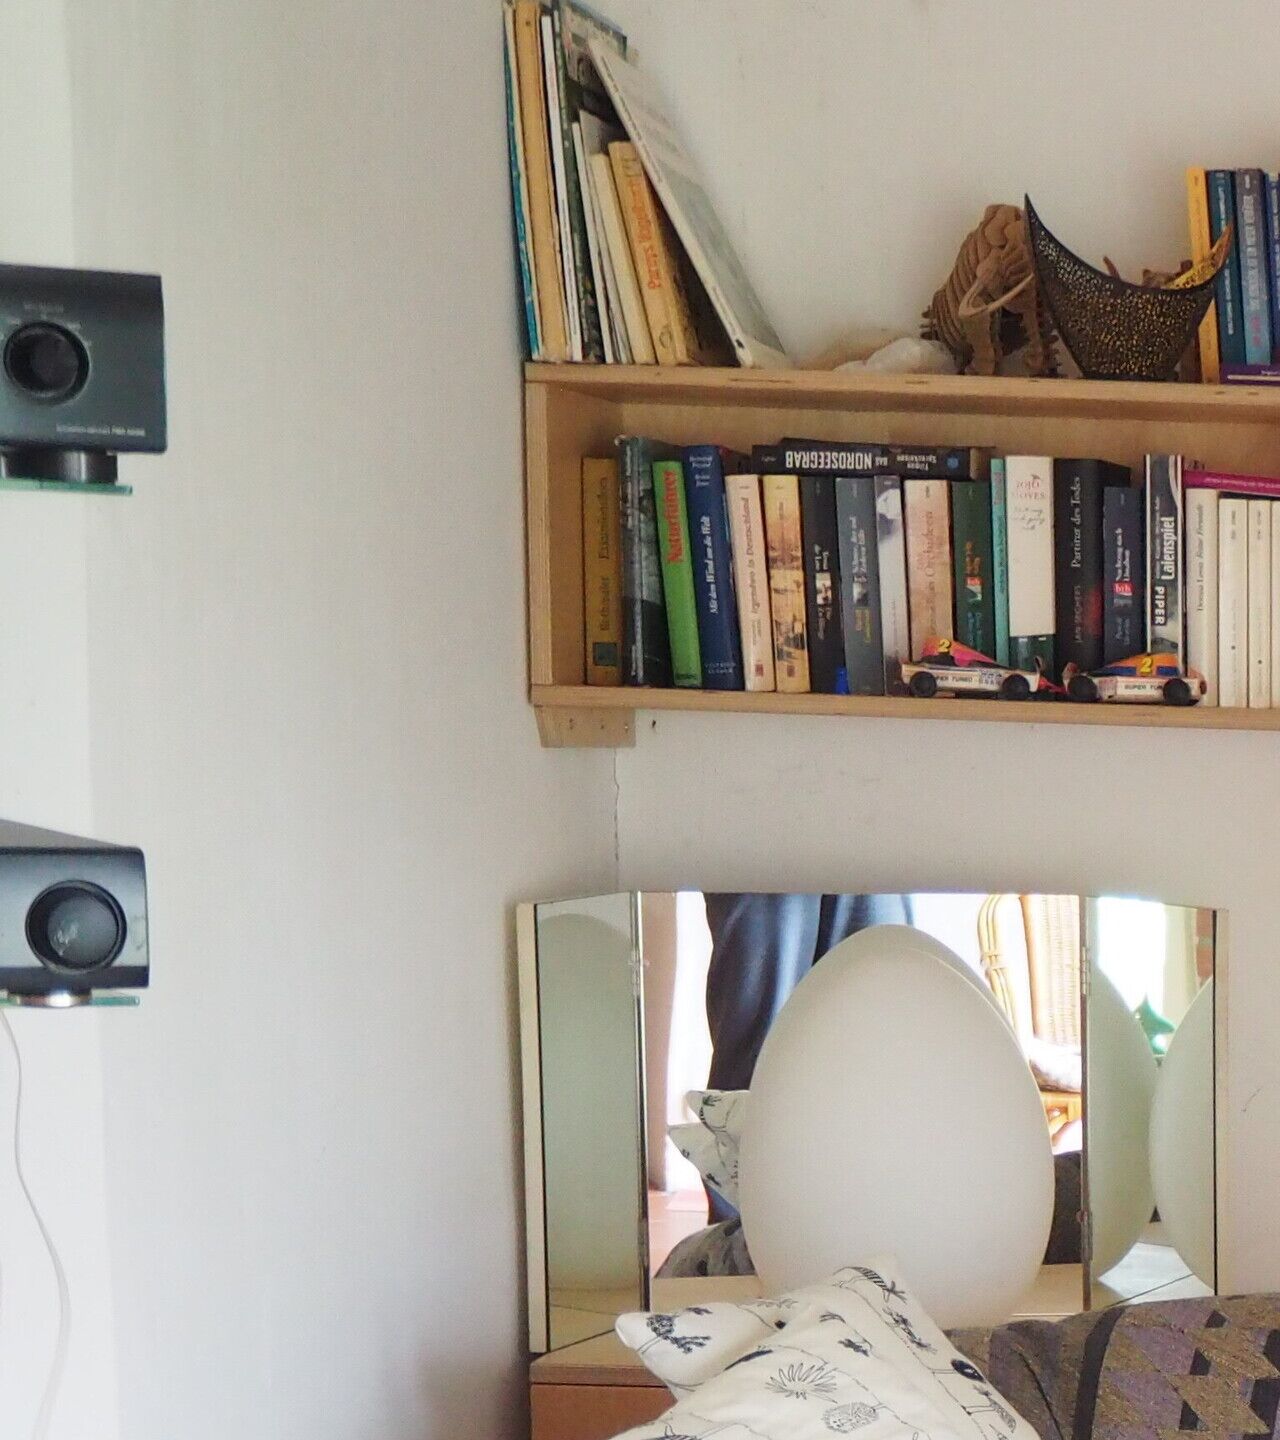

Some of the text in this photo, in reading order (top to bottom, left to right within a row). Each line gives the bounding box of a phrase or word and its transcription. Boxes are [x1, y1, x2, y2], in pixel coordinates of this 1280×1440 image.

[785, 450, 873, 470] NORDSEEGRAB
[1070, 476, 1081, 506] Todes
[742, 496, 755, 556] Deutschland
[1070, 508, 1081, 525] des
[1160, 516, 1176, 580] Laienspiel
[1154, 586, 1166, 624] PIPER
[937, 638, 951, 653] 2
[1140, 656, 1152, 673] 2
